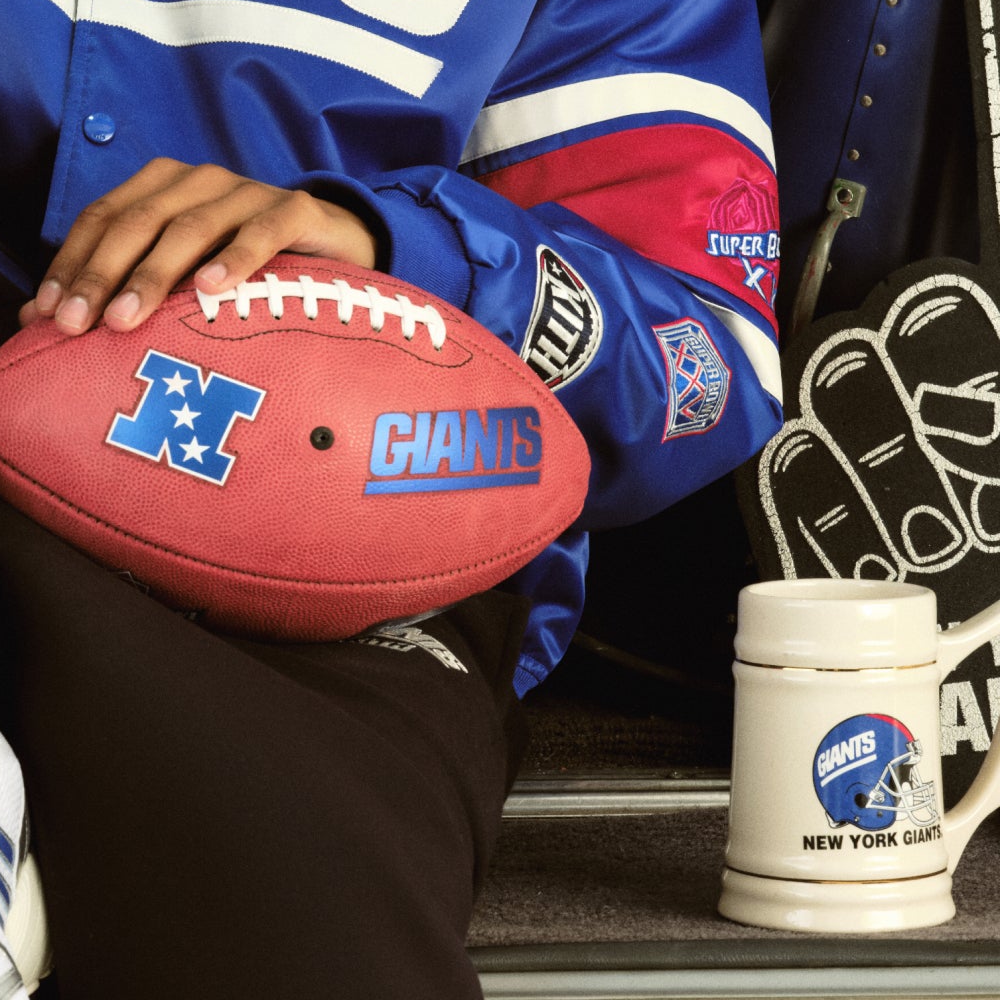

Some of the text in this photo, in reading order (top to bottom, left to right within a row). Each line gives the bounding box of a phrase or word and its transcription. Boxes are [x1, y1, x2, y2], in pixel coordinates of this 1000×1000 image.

[706, 233, 764, 257] SUPER
[531, 281, 587, 377] KITH
[671, 342, 706, 418] XXV
[685, 336, 724, 423] SUPER BOWL
[370, 406, 543, 477] GIANTS
[817, 730, 876, 778] GIANTS
[803, 826, 942, 850] NEW YORK GIANTS
